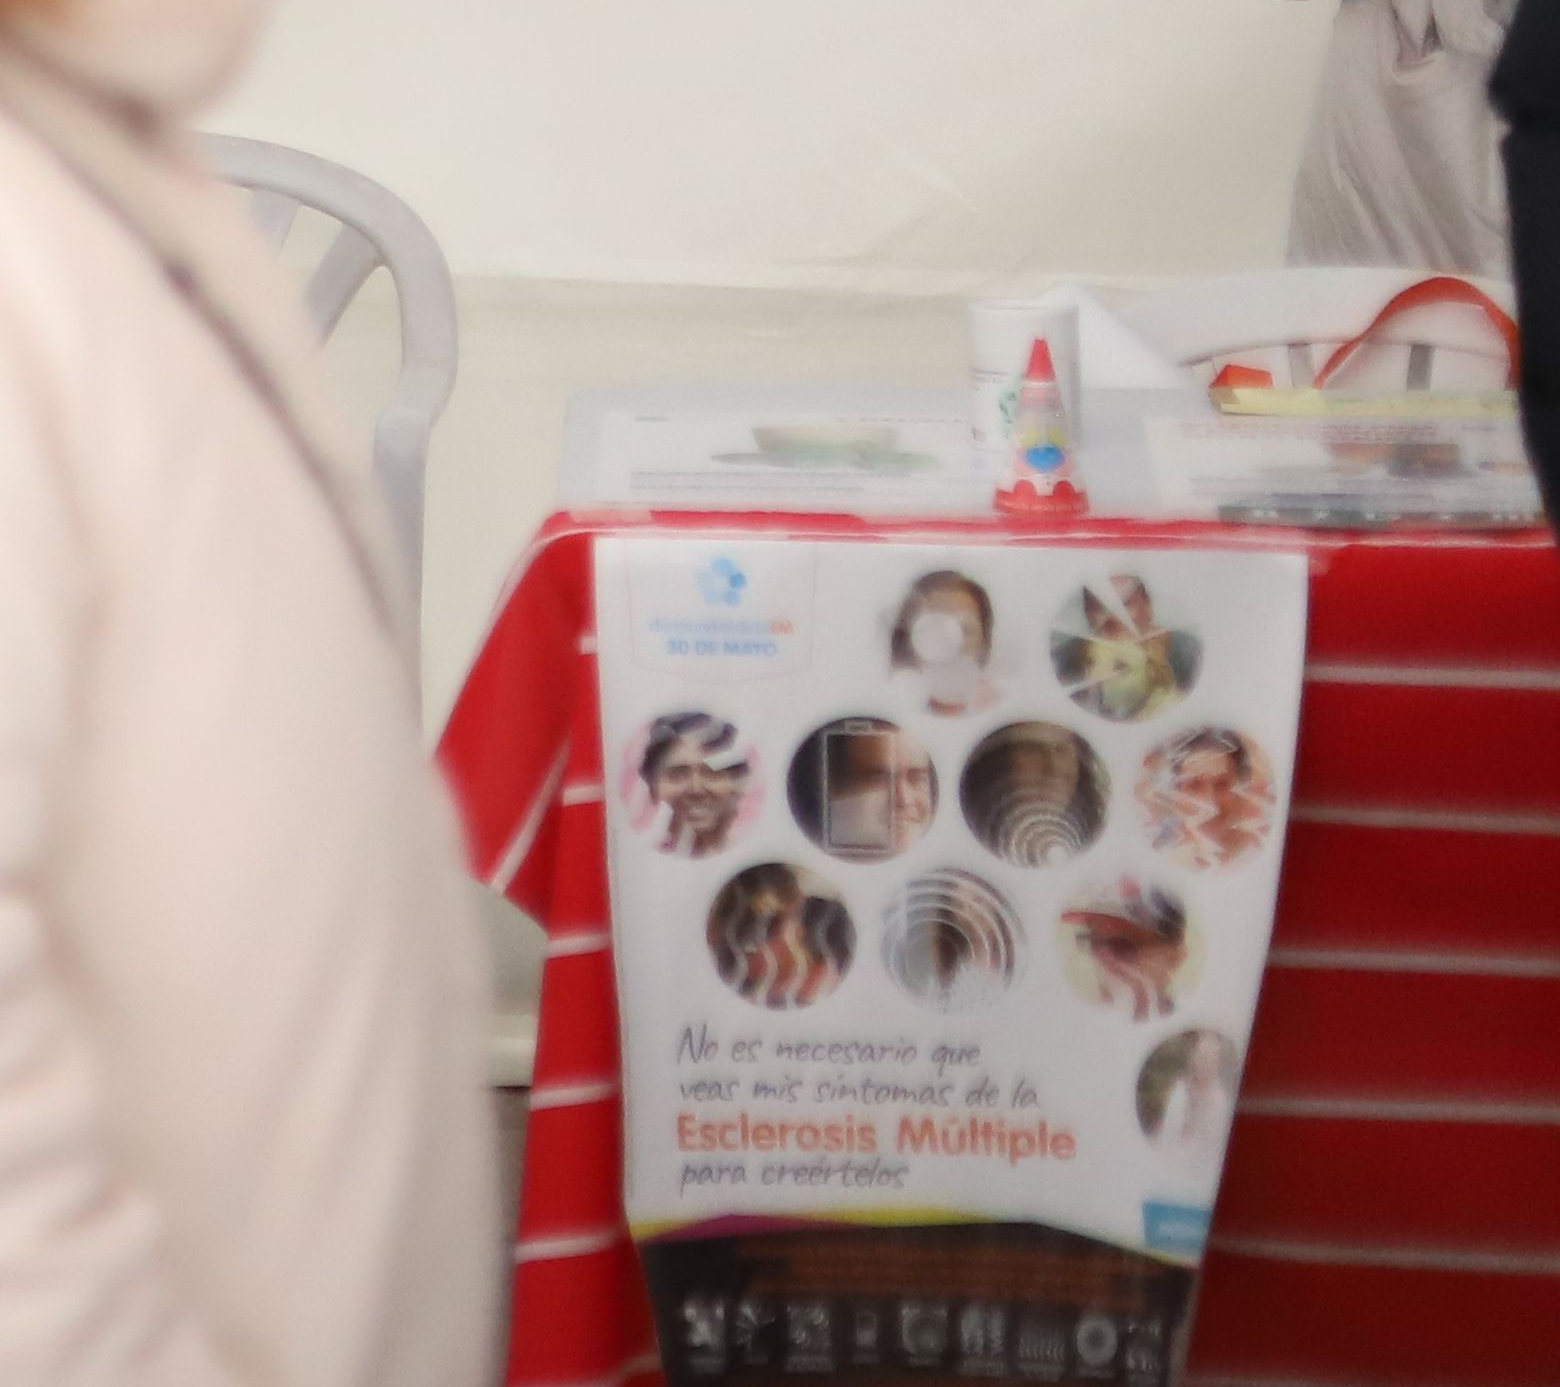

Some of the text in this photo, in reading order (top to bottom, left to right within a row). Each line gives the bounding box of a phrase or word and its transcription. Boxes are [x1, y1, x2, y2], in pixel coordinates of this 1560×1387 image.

[677, 1024, 981, 1080] No es necesario que
[680, 1080, 739, 1103] veas
[753, 1076, 804, 1104] mis
[965, 1075, 999, 1107] de
[1012, 1074, 1038, 1107] la
[676, 1112, 1077, 1167] Esclerosis Múltiple
[680, 1162, 746, 1199] para
